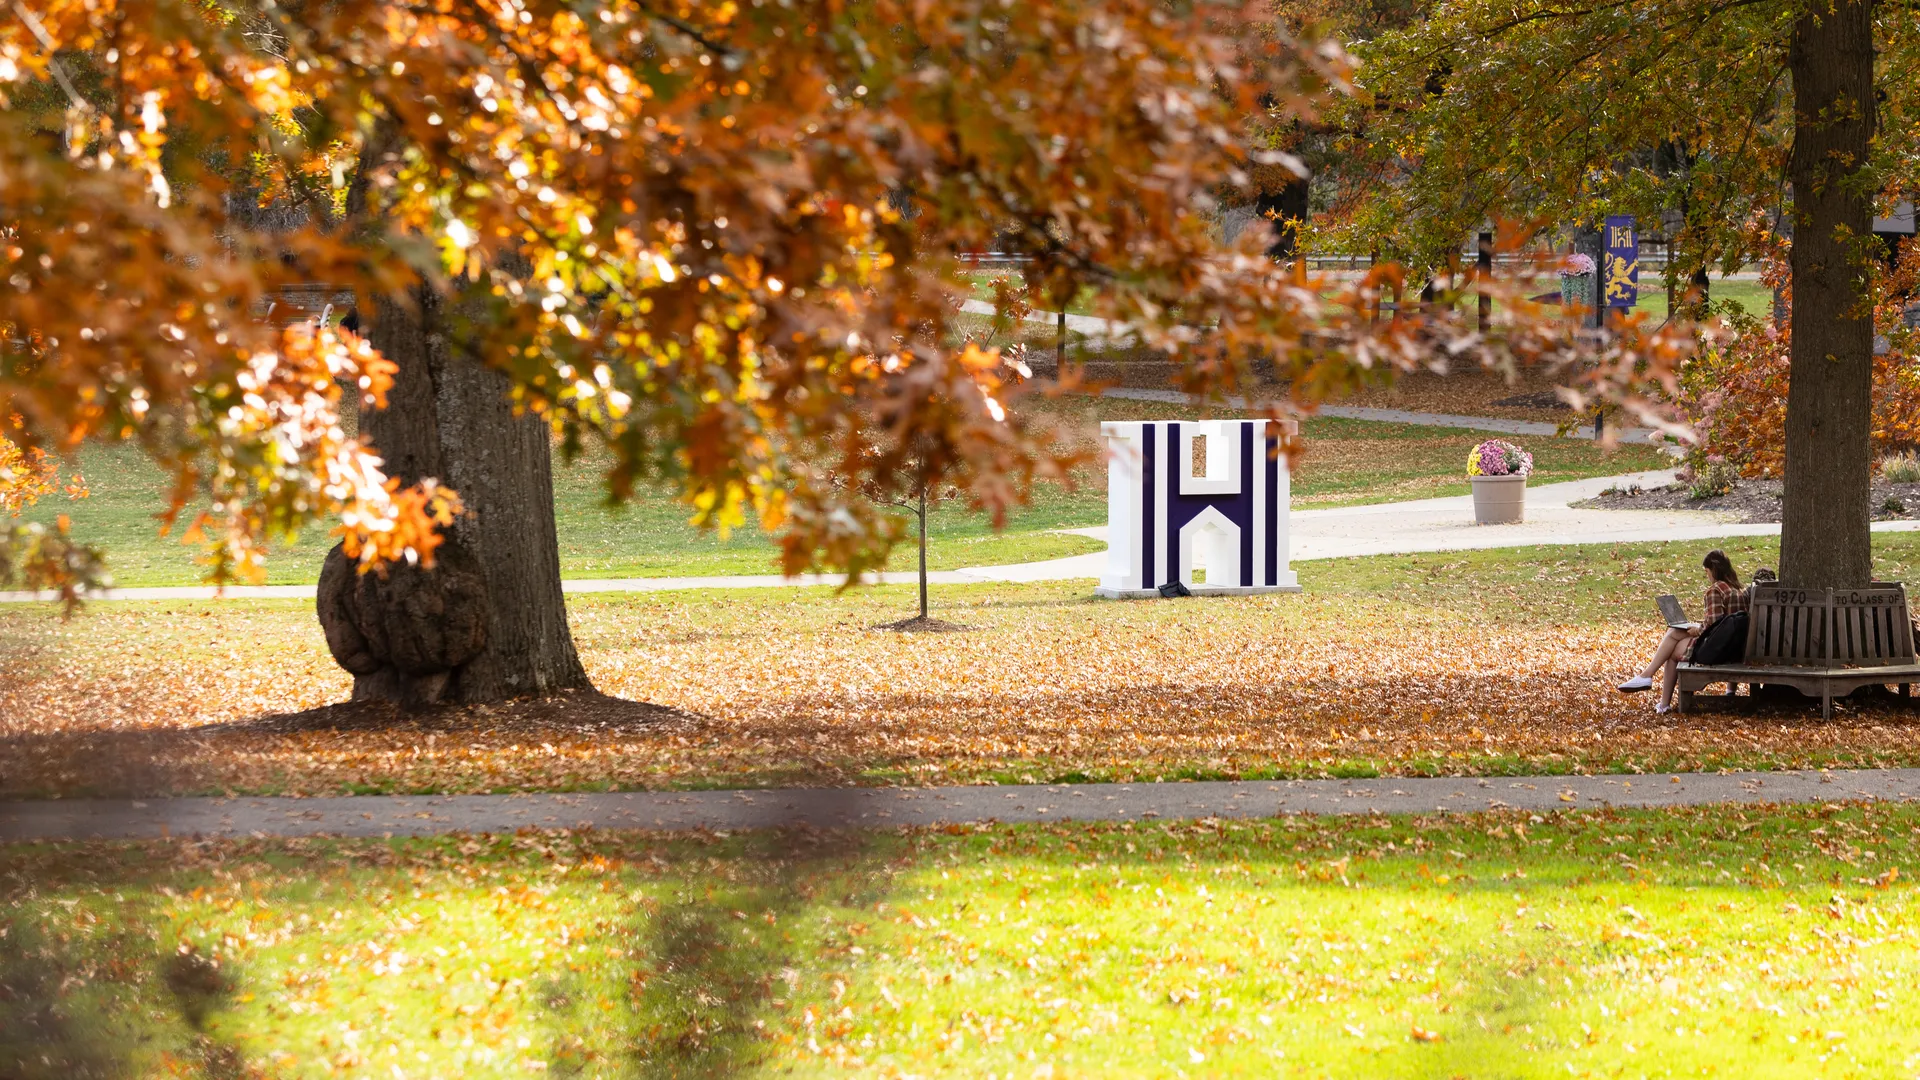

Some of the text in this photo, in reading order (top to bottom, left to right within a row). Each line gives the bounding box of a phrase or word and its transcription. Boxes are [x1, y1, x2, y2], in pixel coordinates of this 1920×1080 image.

[1774, 590, 1807, 605] 1970
[1835, 592, 1900, 605] TO CLASS OF
